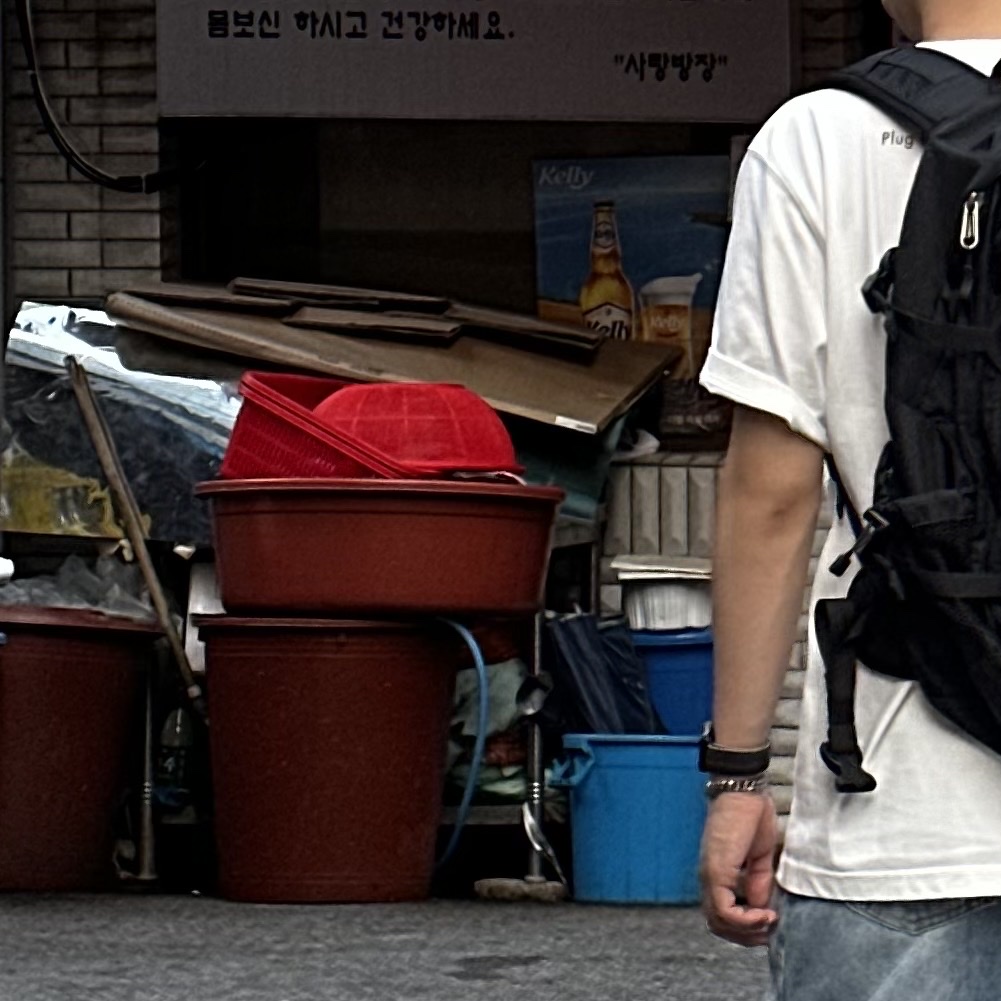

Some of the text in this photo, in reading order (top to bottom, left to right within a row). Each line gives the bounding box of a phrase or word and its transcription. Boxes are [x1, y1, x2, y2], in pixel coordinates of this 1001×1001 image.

[207, 9, 515, 41] 몸보신 하시고 건강하세요.
[881, 129, 914, 150] Plug
[539, 165, 594, 190] Kelly
